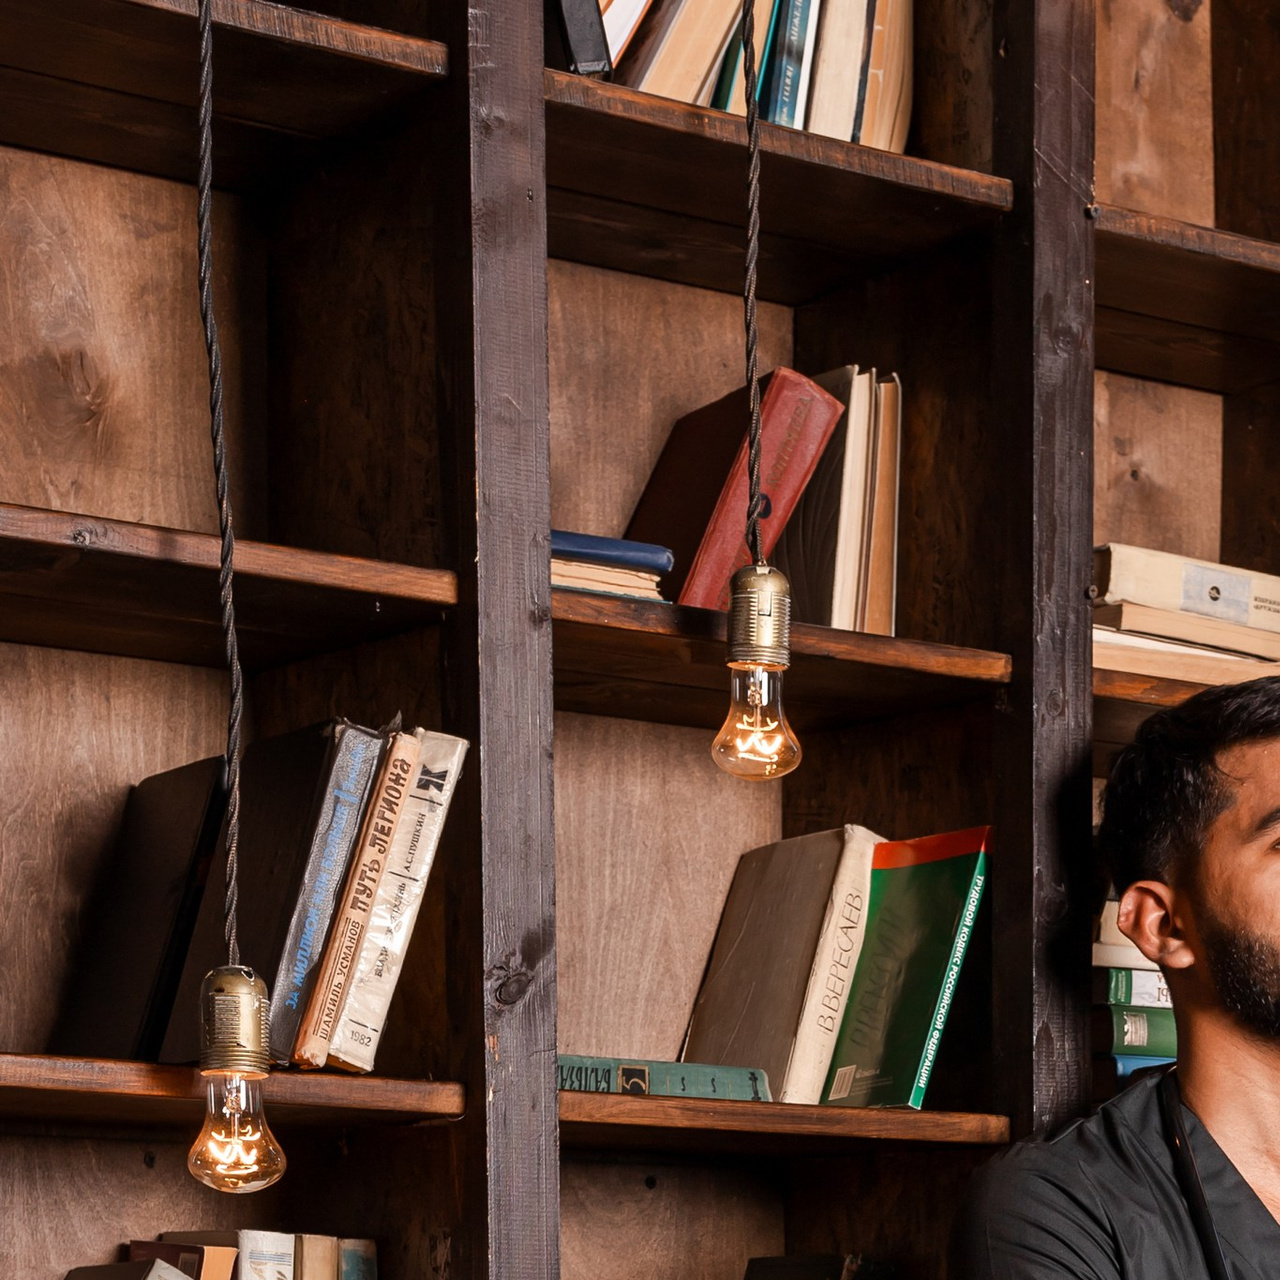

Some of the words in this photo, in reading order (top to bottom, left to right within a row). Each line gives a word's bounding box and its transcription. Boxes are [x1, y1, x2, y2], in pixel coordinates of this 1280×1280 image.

[319, 800, 352, 864] БОЛЬШЕ
[350, 856, 383, 914] ПУТЬ
[368, 757, 413, 854] ЛЕГИОНА
[403, 811, 428, 874] А.С.ПУШКИН
[312, 865, 331, 903] ИЛИ
[964, 873, 985, 927] ТРУДОВОЙ
[293, 902, 321, 986] МИЛЛИОН
[951, 927, 972, 966] КОДЕКС
[284, 990, 300, 1010] ЗА
[318, 982, 346, 1041] ШАМИЛЬ
[337, 919, 362, 980] УСМАНОВ
[934, 965, 958, 1026] РОССИЙСКОЙ
[349, 1029, 373, 1048] 1982
[916, 1026, 942, 1089] ФЕДЕРАЦИИ
